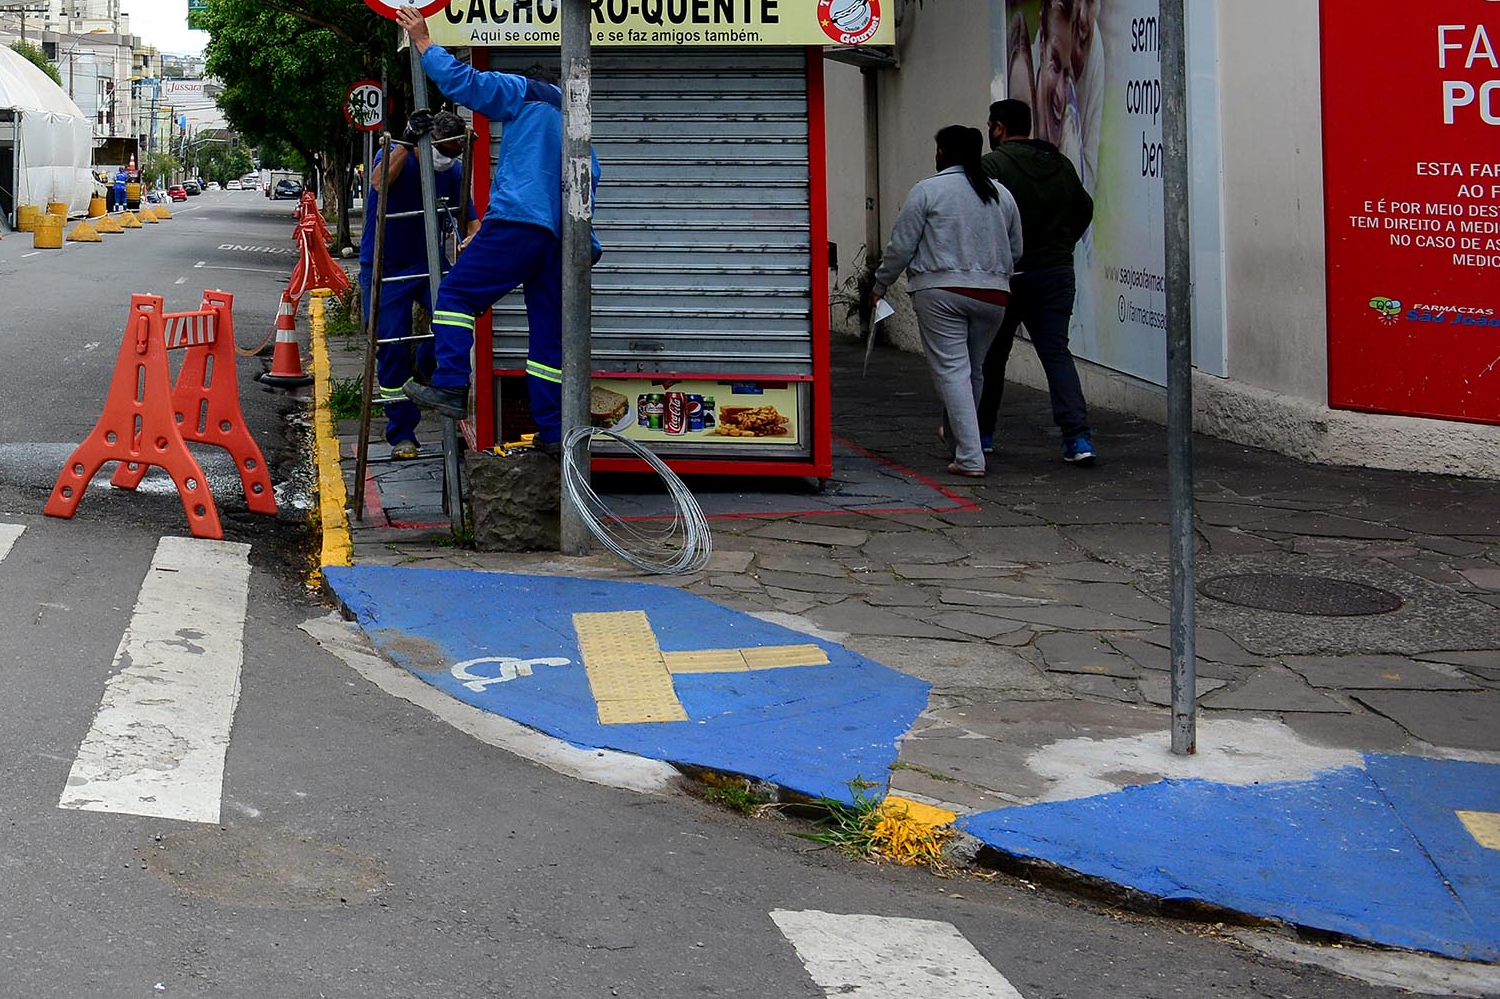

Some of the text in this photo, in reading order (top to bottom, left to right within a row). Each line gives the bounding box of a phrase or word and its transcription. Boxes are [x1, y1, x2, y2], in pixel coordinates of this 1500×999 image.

[470, 28, 763, 45] Aqui se come e se faz amigos também.
[840, 15, 880, 44] Gourmet
[168, 83, 202, 92] Jussara
[1416, 162, 1463, 177] ESTA
[1457, 184, 1484, 198] AO
[1364, 201, 1373, 213] E
[1377, 198, 1387, 213] É
[1391, 202, 1421, 215] POR
[1425, 203, 1463, 216] MEIO
[1349, 216, 1379, 229] TEM
[1384, 217, 1441, 232] DIREITO
[1445, 220, 1456, 233] A
[1390, 234, 1411, 247] NO
[1415, 235, 1456, 249] CASO
[1460, 238, 1481, 250] DE
[1412, 303, 1495, 316] FARMÁCIAS
[1406, 309, 1500, 328] São João
